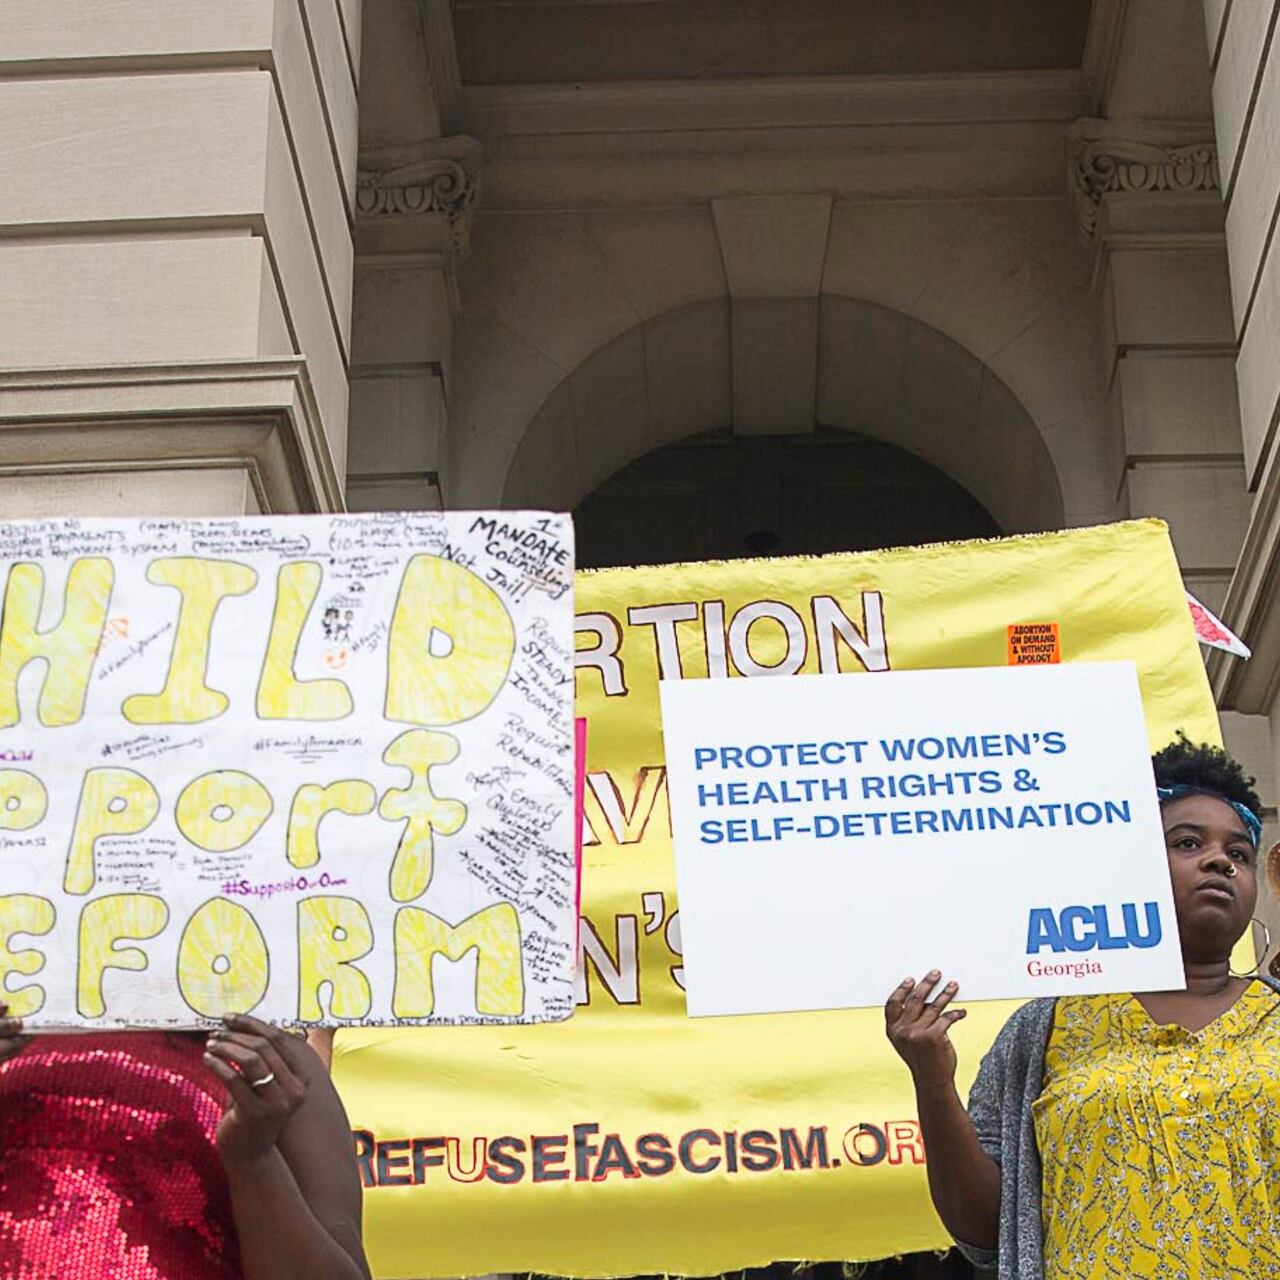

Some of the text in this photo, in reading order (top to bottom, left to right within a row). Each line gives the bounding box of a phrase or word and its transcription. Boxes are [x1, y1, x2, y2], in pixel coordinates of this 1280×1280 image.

[484, 540, 571, 601] Counseling
[1010, 634, 1056, 645] ON DEMAND
[1014, 625, 1052, 635] ABORTION
[1012, 643, 1055, 655] & WITHOUT
[1017, 653, 1051, 664] APOLOGY
[694, 731, 1067, 770] PROTECT WOMEN'S
[697, 769, 1040, 807] HEALTH RIGHTS &
[699, 800, 1132, 844] SELF-DETERMINATION
[1025, 901, 1162, 955] ACLU
[1027, 960, 1103, 979] Georgia
